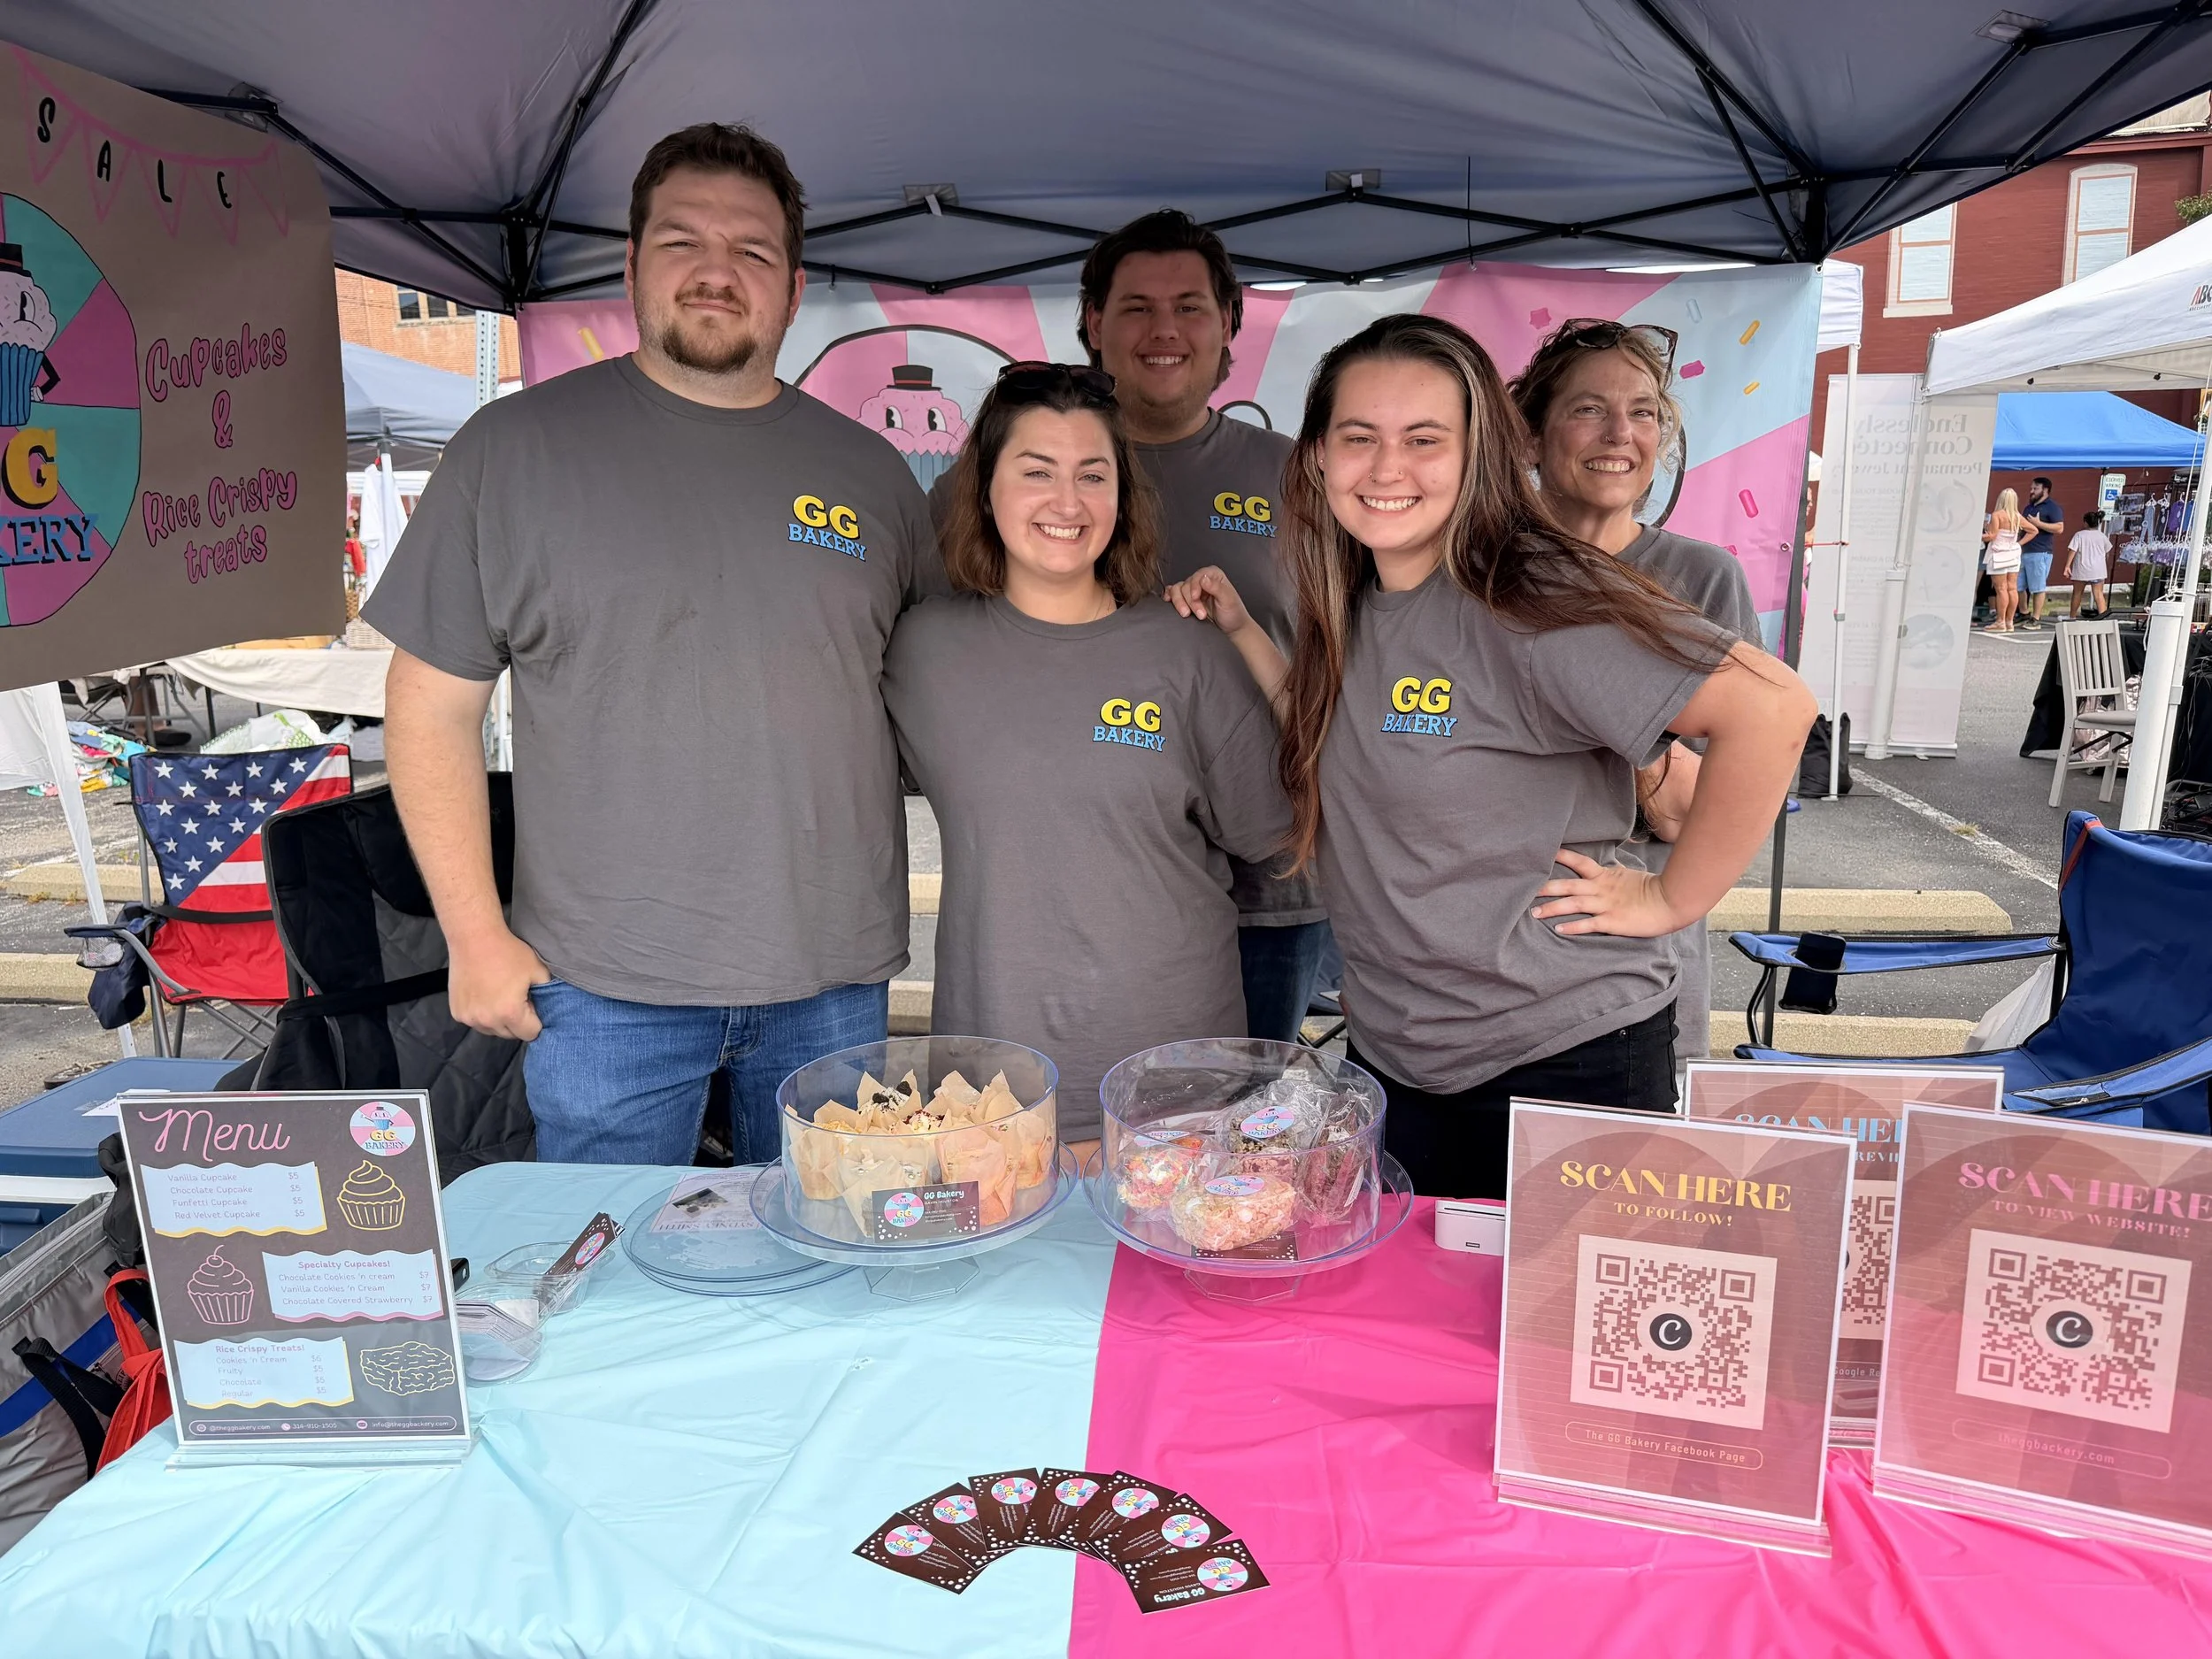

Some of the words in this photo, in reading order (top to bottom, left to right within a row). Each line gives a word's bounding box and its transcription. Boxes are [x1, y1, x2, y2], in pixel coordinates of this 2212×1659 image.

[145, 323, 288, 402] Cupcakes
[212, 390, 233, 449] &
[142, 491, 201, 547] Rice
[208, 467, 297, 527] Crispy
[793, 495, 860, 539] GG
[1213, 491, 1271, 522] GG
[1209, 515, 1277, 538] BAKERY
[185, 524, 267, 584] treats
[787, 523, 866, 562] BAKERY
[1391, 676, 1452, 714] GG
[1100, 697, 1161, 733] GG
[1381, 713, 1457, 737] BAKERY
[1093, 726, 1166, 752] BAKERY
[139, 1109, 290, 1162] Menu
[370, 1130, 397, 1142] GG
[201, 1173, 237, 1183] Cupcake
[288, 1171, 299, 1180] $5
[217, 1186, 253, 1195] Cupcake
[290, 1184, 301, 1193] $5
[1560, 1160, 1666, 1198] SCAN
[1678, 1173, 1792, 1211] HERE
[173, 1198, 209, 1207] Funfetti
[211, 1198, 248, 1207] Cupcake
[293, 1196, 303, 1205] $5
[937, 1190, 964, 1200] Bakery
[1958, 1162, 2076, 1202] SCAN
[2088, 1179, 2212, 1222] HERE
[194, 1210, 221, 1219] Velvet
[224, 1210, 260, 1219] Cupcake
[295, 1209, 305, 1217] $5
[1614, 1202, 1639, 1216] TO
[1646, 1206, 1732, 1226] FOLLOW!
[1993, 1200, 2018, 1213] TO
[2025, 1204, 2077, 1221] VIEW
[2085, 1213, 2191, 1239] WEBSITE!
[298, 1261, 342, 1271] Specialty
[343, 1260, 390, 1270] Cupcakes!
[365, 1296, 413, 1305] Strawberry
[237, 1345, 267, 1354] Crispy
[218, 1367, 243, 1376] Fruity
[1585, 1430, 1604, 1440] The
[1608, 1432, 1621, 1443] GG
[1624, 1436, 1661, 1451] Bakery
[1664, 1441, 1715, 1458] Facebook
[1718, 1450, 1745, 1463] Page
[1998, 1432, 2115, 1465] theggbackery.com
[1202, 1559, 1233, 1571] BAKERY
[1154, 1590, 1188, 1602] Bakery
[1190, 1587, 1205, 1596] GG
